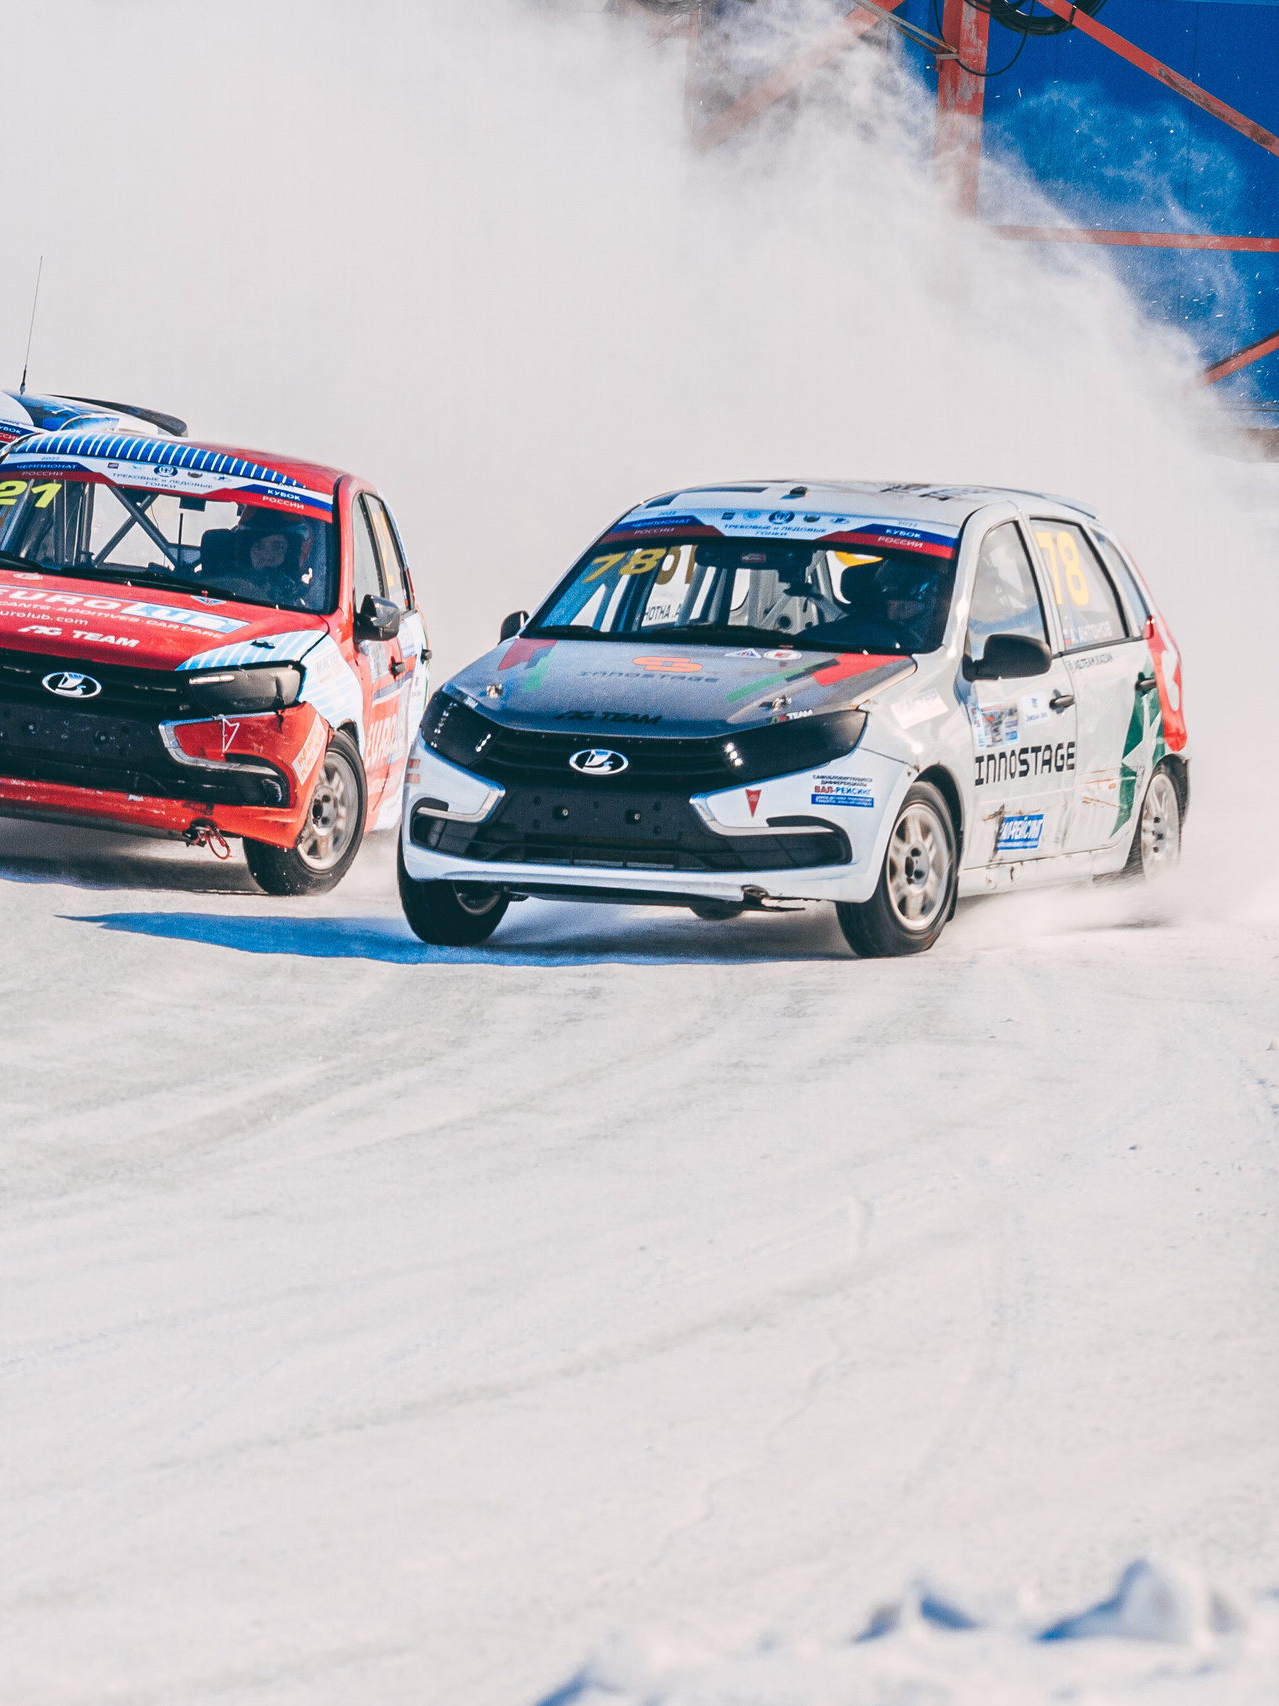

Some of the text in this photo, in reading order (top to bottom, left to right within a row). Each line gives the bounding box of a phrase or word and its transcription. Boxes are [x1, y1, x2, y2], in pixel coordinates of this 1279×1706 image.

[112, 472, 160, 483] ТРЕКОВЫЕ
[168, 479, 213, 489] ЛЕДОВЫЕ
[145, 481, 177, 490] ГОНКИ
[267, 488, 301, 501] КУБОК
[262, 496, 305, 510] РОССИИ
[631, 518, 691, 528] ЧЕМПИОНАТ
[781, 525, 827, 534] ЛЕДОВЫЕ
[634, 527, 675, 535] РОССИИ
[885, 528, 922, 540] КУБОК
[877, 536, 924, 549] РОССИИ
[582, 547, 668, 584] 78
[1033, 530, 1090, 607] 78
[71, 629, 140, 648] TEAM
[577, 670, 720, 684] INNOSTAGE
[599, 711, 663, 725] TEAM
[786, 708, 814, 721] TEAM
[975, 741, 1076, 787] INNOSTAGE
[814, 785, 872, 796] ВАЛ-РЕЙСИНГ
